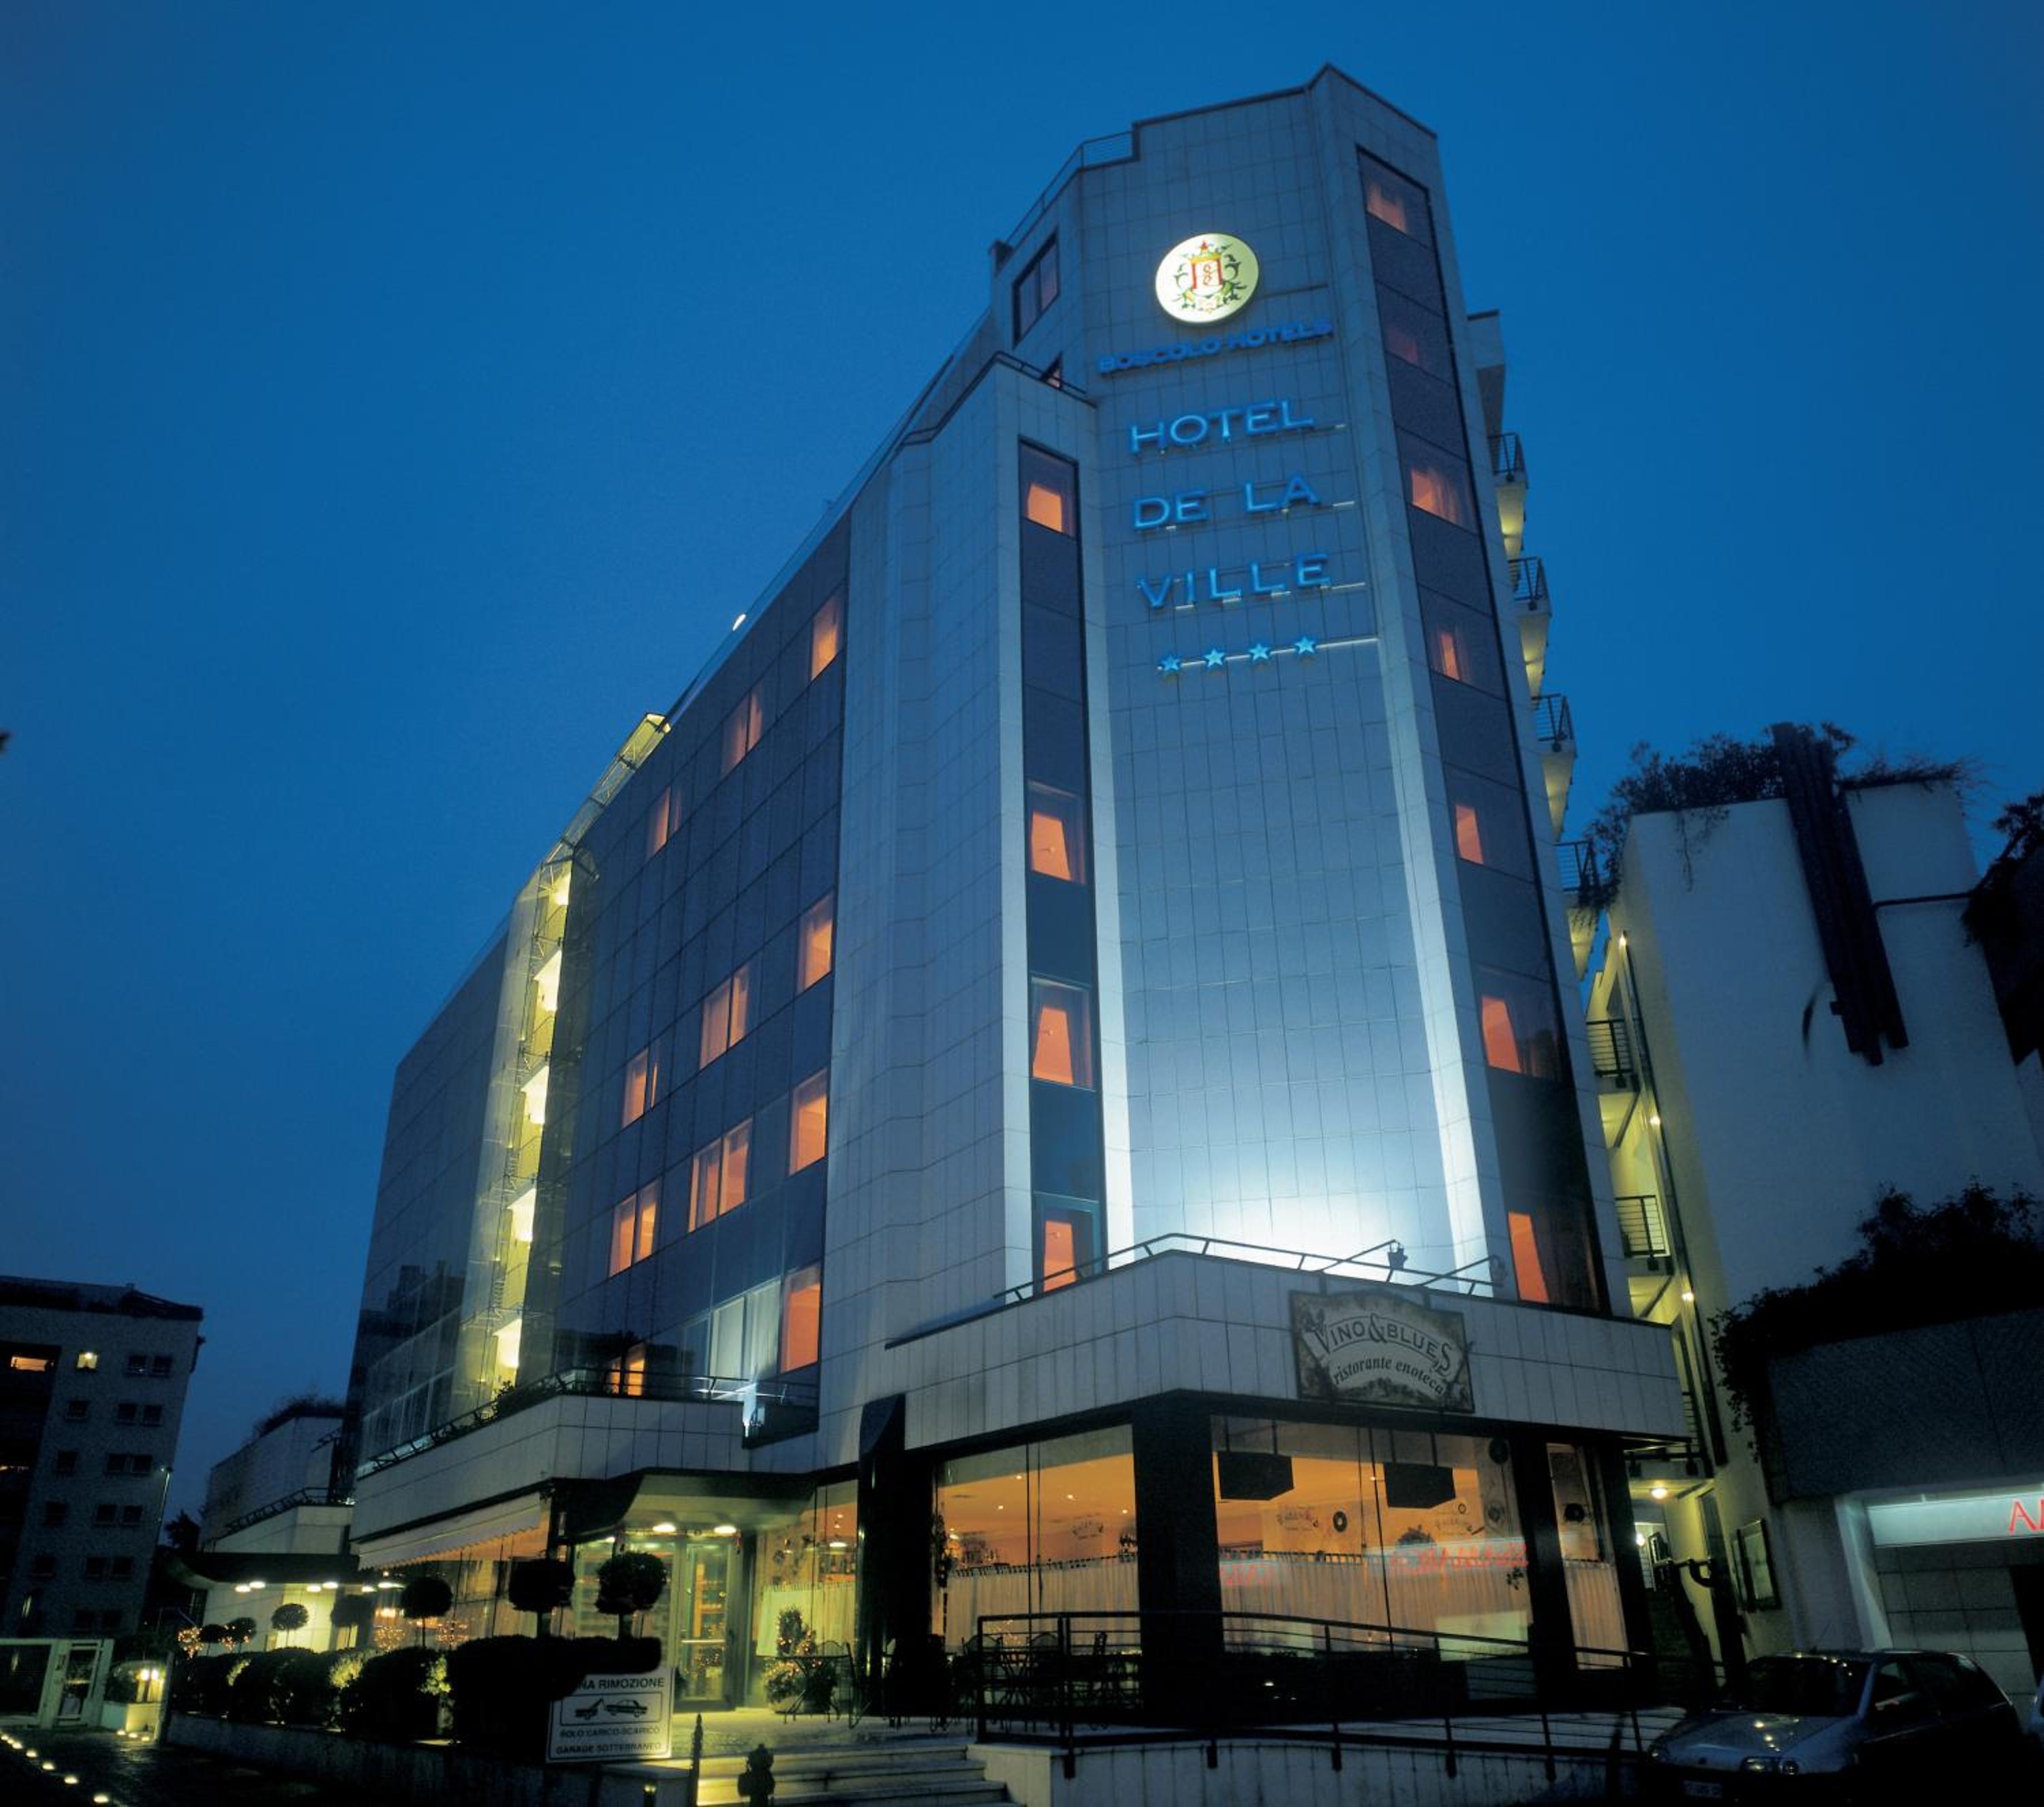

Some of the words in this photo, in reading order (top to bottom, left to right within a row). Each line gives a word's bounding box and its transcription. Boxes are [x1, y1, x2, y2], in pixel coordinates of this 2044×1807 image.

[1098, 338, 1221, 372] BOSCOLO
[1228, 320, 1331, 350] HOTELS
[1130, 399, 1314, 454] HOTEL
[1133, 489, 1208, 531] DE
[1245, 474, 1320, 513] LA
[1137, 553, 1330, 608] VILLE
[2009, 1498, 2044, 1534] A
[599, 1678, 665, 1689] RIMOZIONE
